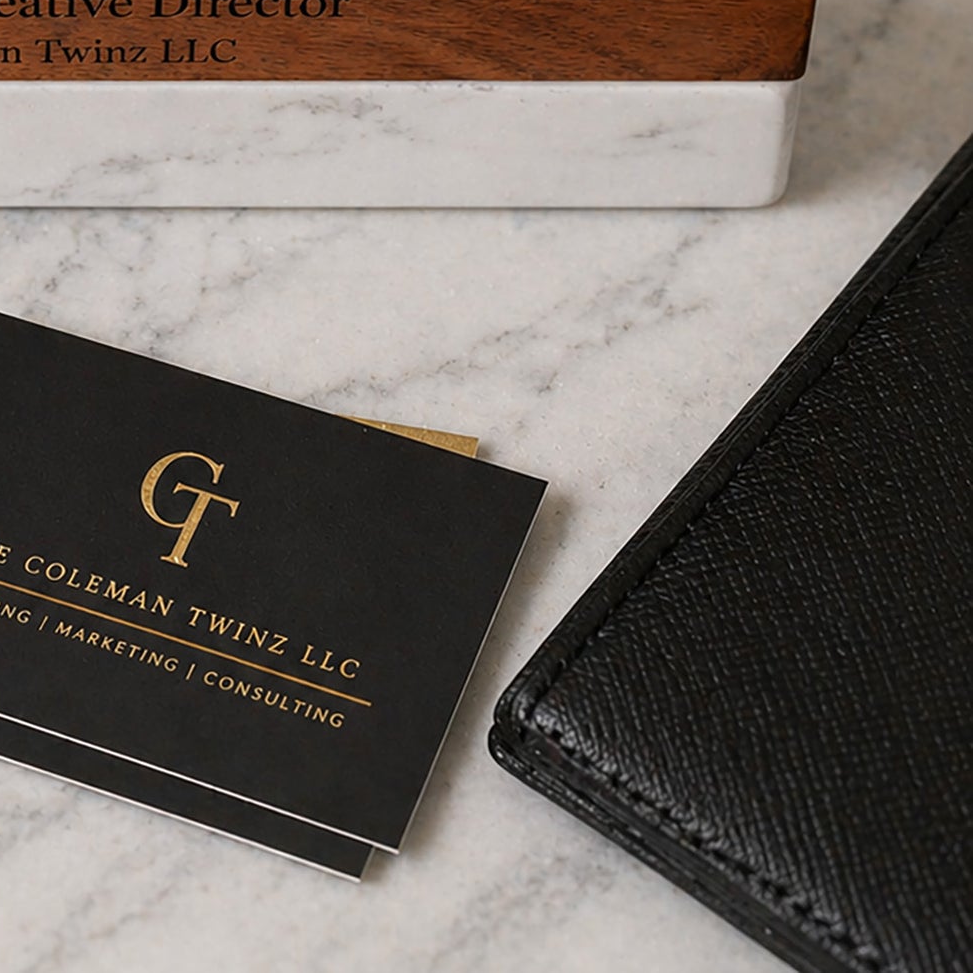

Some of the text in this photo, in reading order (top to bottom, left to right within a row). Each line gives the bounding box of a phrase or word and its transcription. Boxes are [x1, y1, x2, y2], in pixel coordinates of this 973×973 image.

[36, 38, 148, 65] Twinz
[160, 39, 238, 65] LLC
[23, 555, 175, 617] COLEMAN
[187, 606, 290, 655] TWINZ
[300, 644, 361, 680] LLC
[54, 620, 179, 672] MARKETING
[202, 670, 345, 728] CONSULTING
